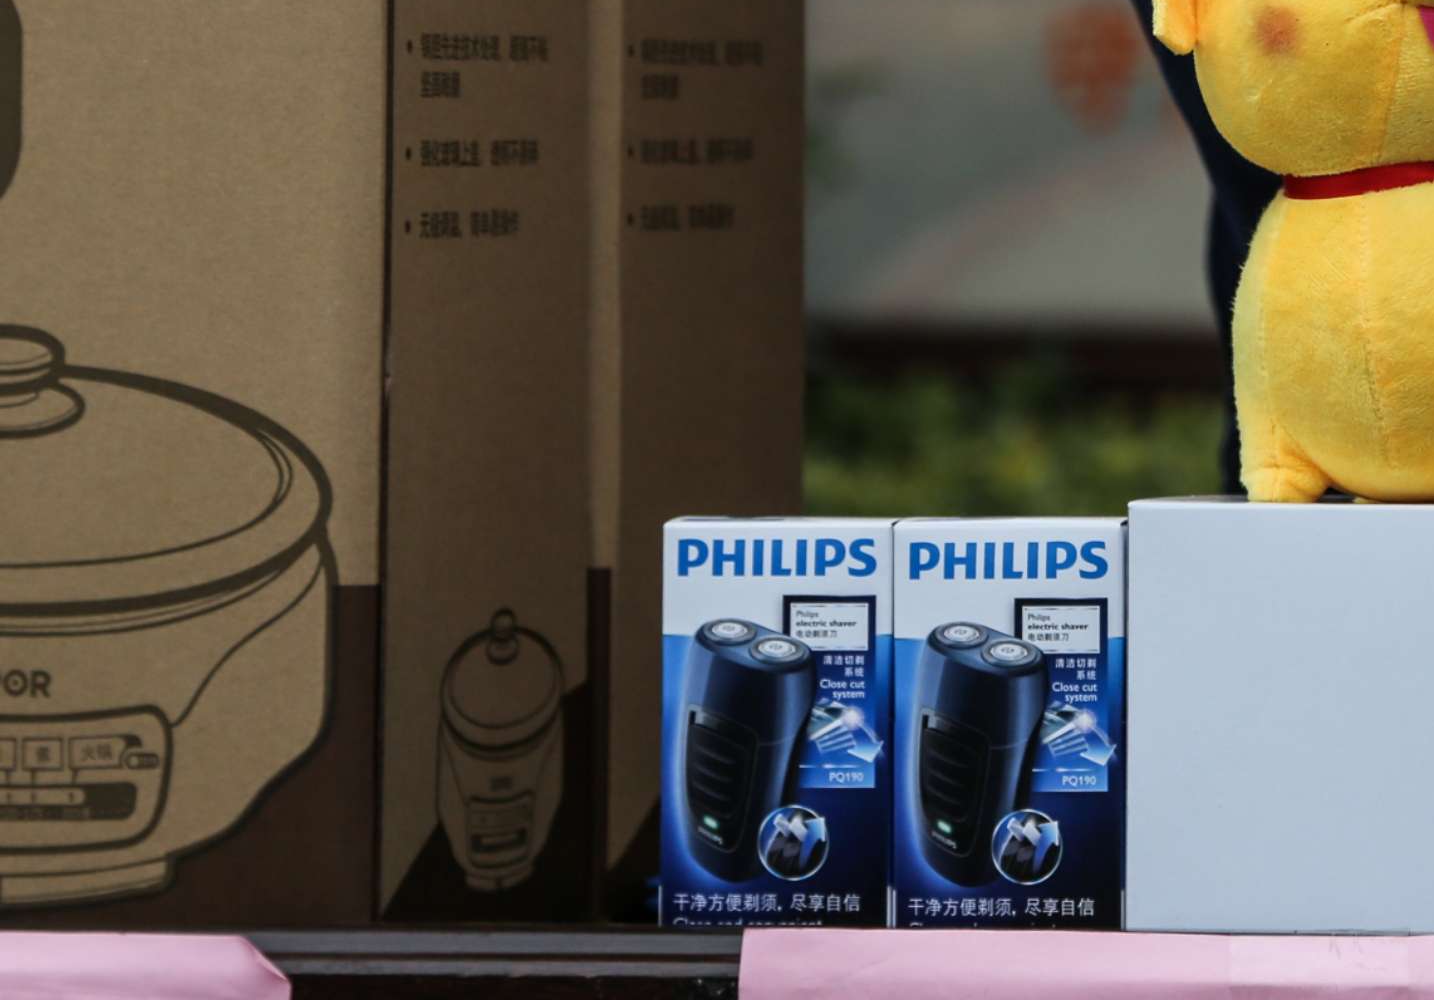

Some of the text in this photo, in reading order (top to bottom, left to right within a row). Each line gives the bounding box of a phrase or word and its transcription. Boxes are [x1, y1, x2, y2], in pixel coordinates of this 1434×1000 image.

[677, 538, 877, 577] PHILIPS
[909, 541, 1109, 580] PHILIPS
[796, 610, 819, 619] Philips
[1027, 613, 1051, 622] Philips
[796, 619, 857, 628] electric shaver
[1027, 622, 1088, 631] electric shaver
[0, 669, 52, 698] OR
[819, 679, 865, 689] Close cut
[1051, 681, 1098, 692] Close cut
[832, 690, 865, 700] system
[1064, 693, 1098, 704] system
[829, 772, 864, 783] PQ190
[1062, 775, 1097, 787] PQ190
